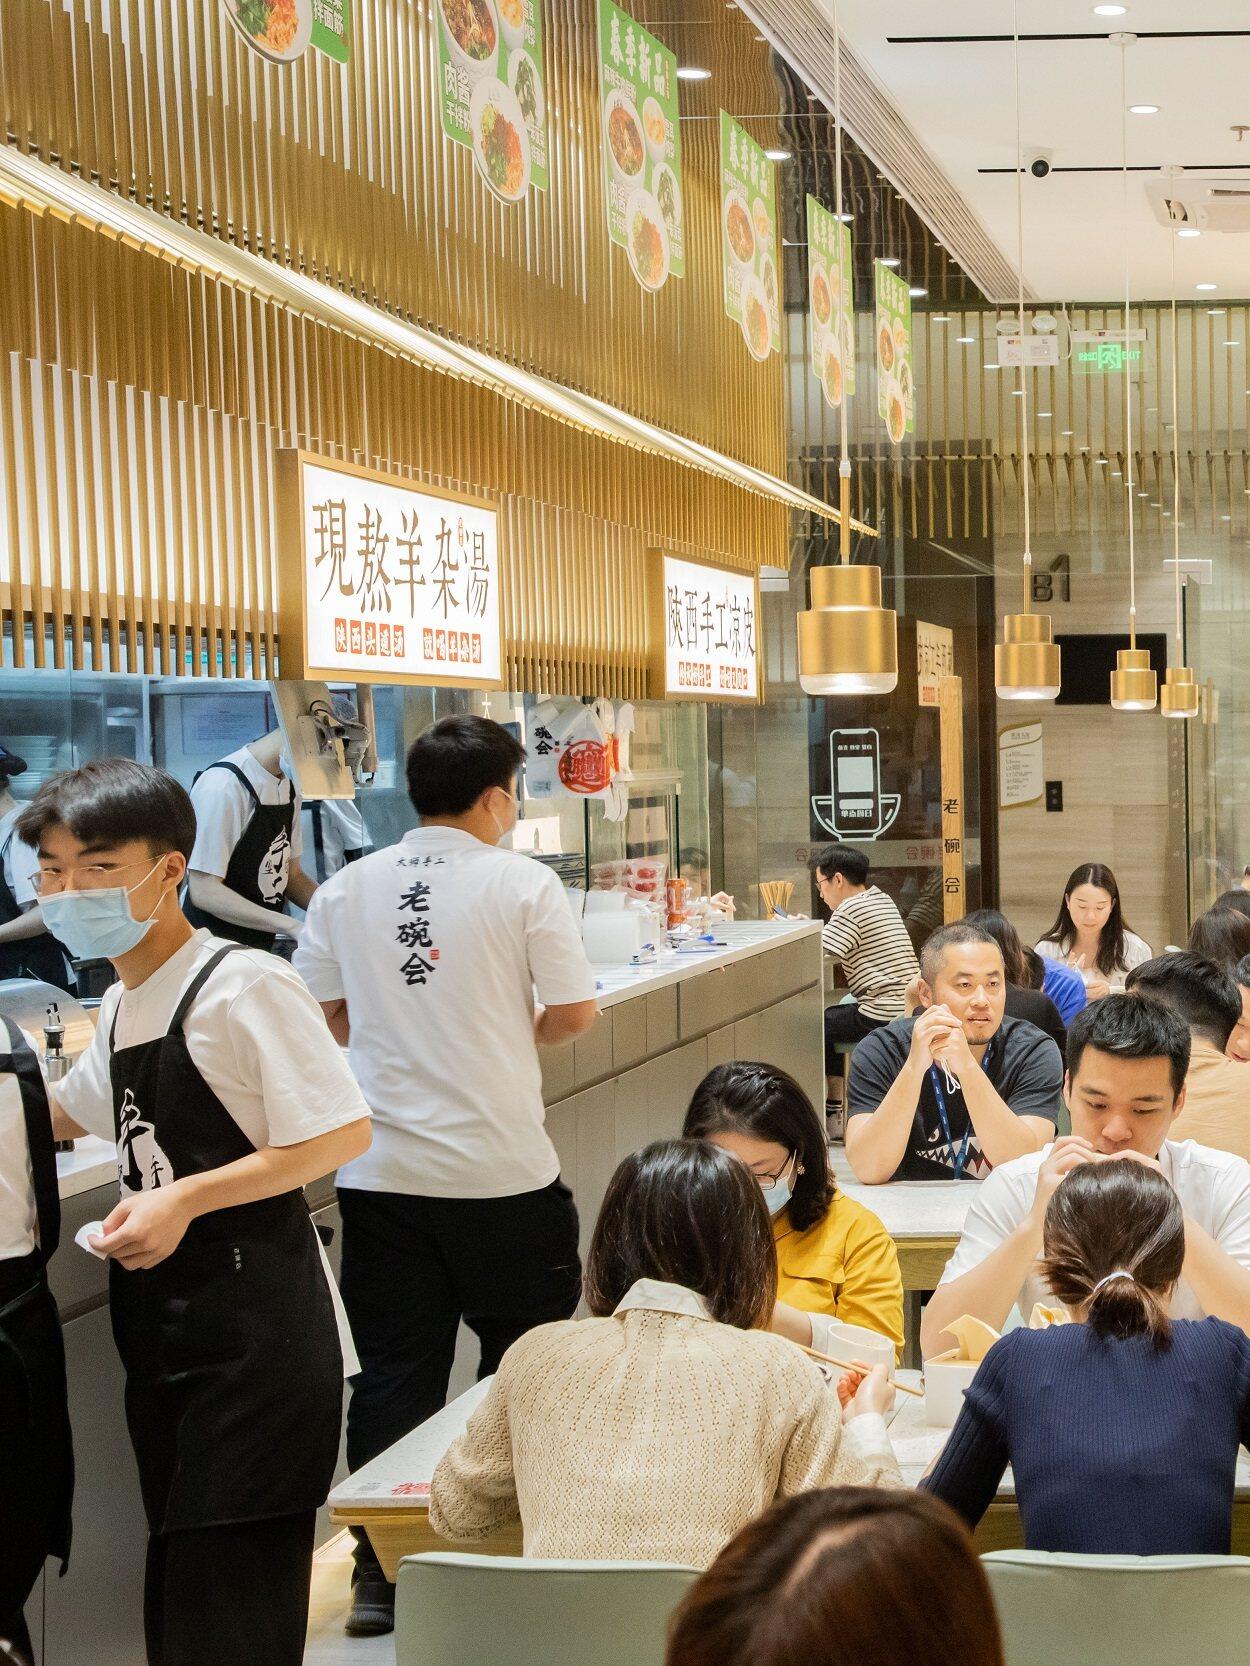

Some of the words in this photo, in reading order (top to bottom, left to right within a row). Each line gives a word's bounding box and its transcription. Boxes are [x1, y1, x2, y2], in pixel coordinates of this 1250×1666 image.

[610, 11, 665, 97] 春季新品
[943, 799, 961, 894] 老碗会
[395, 881, 436, 985] 老碗会
